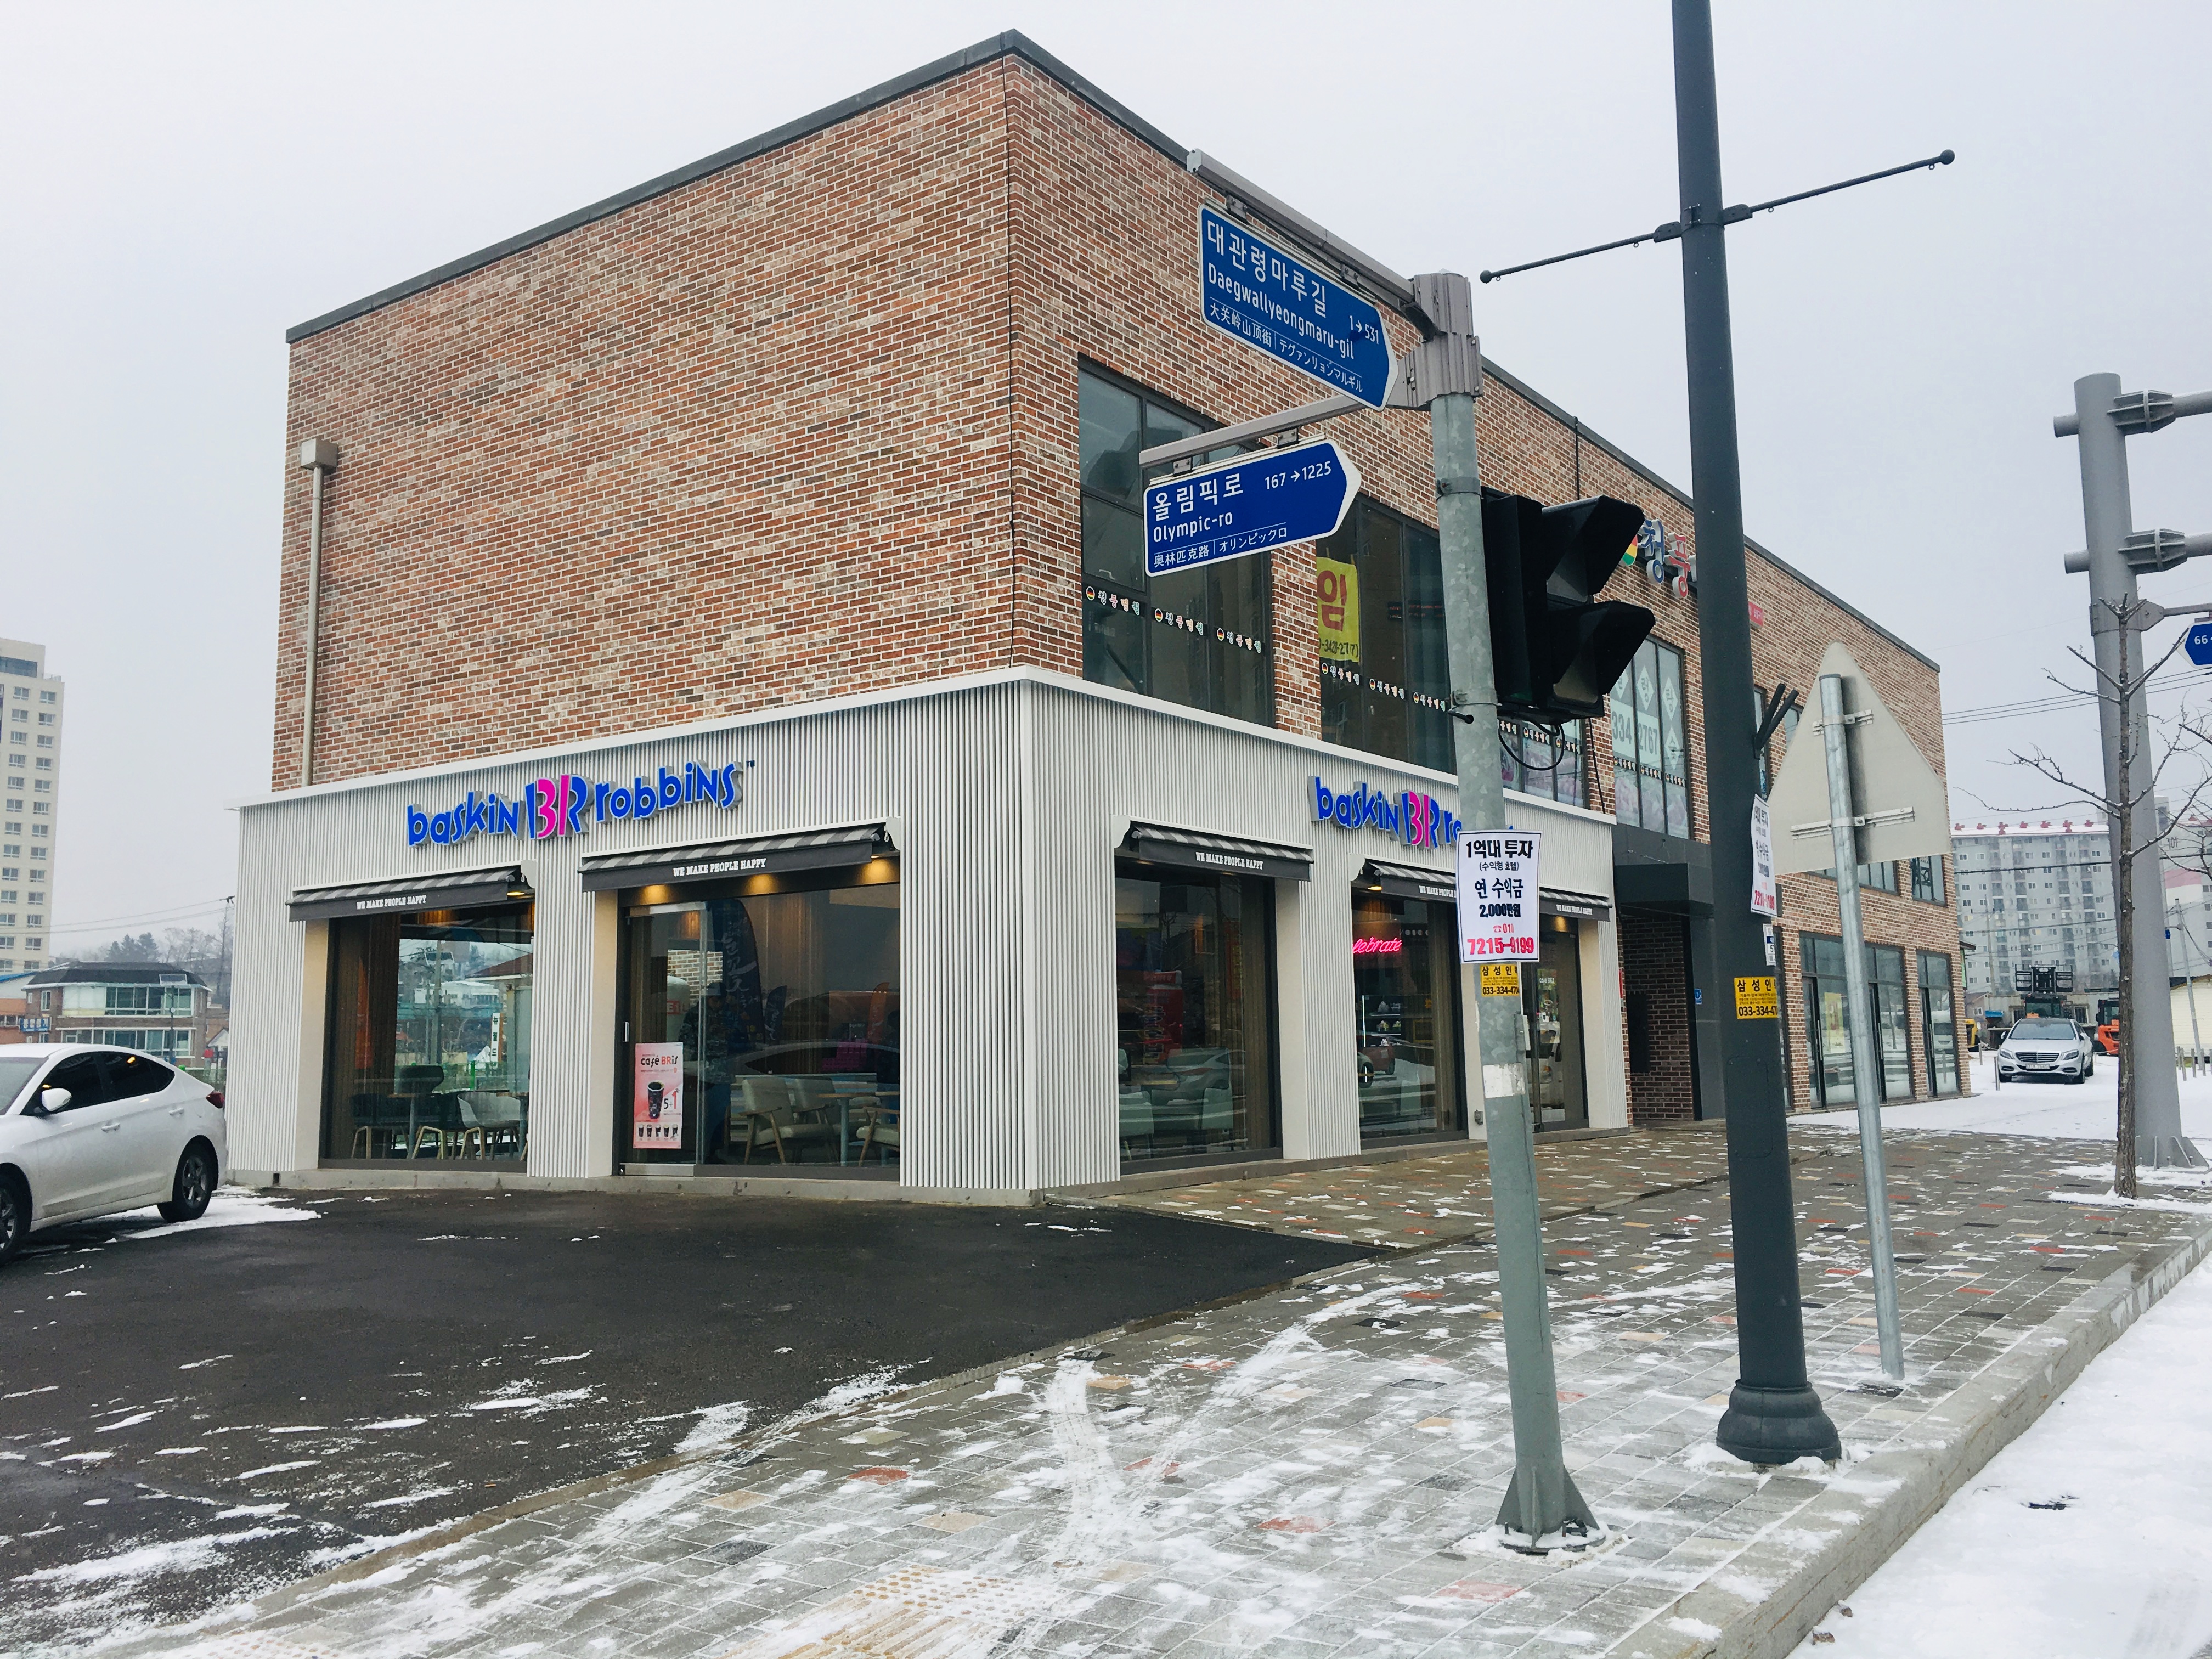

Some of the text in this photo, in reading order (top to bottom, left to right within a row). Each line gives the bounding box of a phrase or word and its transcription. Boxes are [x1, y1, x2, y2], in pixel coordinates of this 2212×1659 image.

[1207, 219, 1327, 318] 대관령마루길
[1208, 262, 1355, 360] Daegwallyeongmaru-gil
[1210, 302, 1272, 348] 大关岭山顶街
[1349, 315, 1380, 345] 1 531
[1279, 338, 1363, 393] テグァンリョンマルギル
[1265, 460, 1332, 490] 167 1225
[1152, 473, 1244, 522] 올림픽로
[1153, 512, 1233, 543] Olympic-ro
[1219, 527, 1287, 552] オリンピックロ
[1154, 545, 1210, 568] 奥林匹克路
[1317, 569, 1347, 632] 임
[2194, 635, 2208, 645] 66
[1612, 710, 1632, 744] 334
[1637, 723, 1658, 755] 2767
[524, 774, 589, 840] BR
[1195, 851, 1263, 870] WE MAKE PEOPLE HAPPY
[1466, 840, 1533, 859] 1억대 투자
[673, 858, 766, 877] WE MAKE PEOPLE HAPPY
[1475, 878, 1524, 899] 연 수익금
[357, 895, 427, 910] WE MAKE PEOPLE HAPPY
[1352, 937, 1402, 953] lebrate
[1467, 936, 1534, 955] 7215-9199
[1737, 979, 1776, 992] 삼성인
